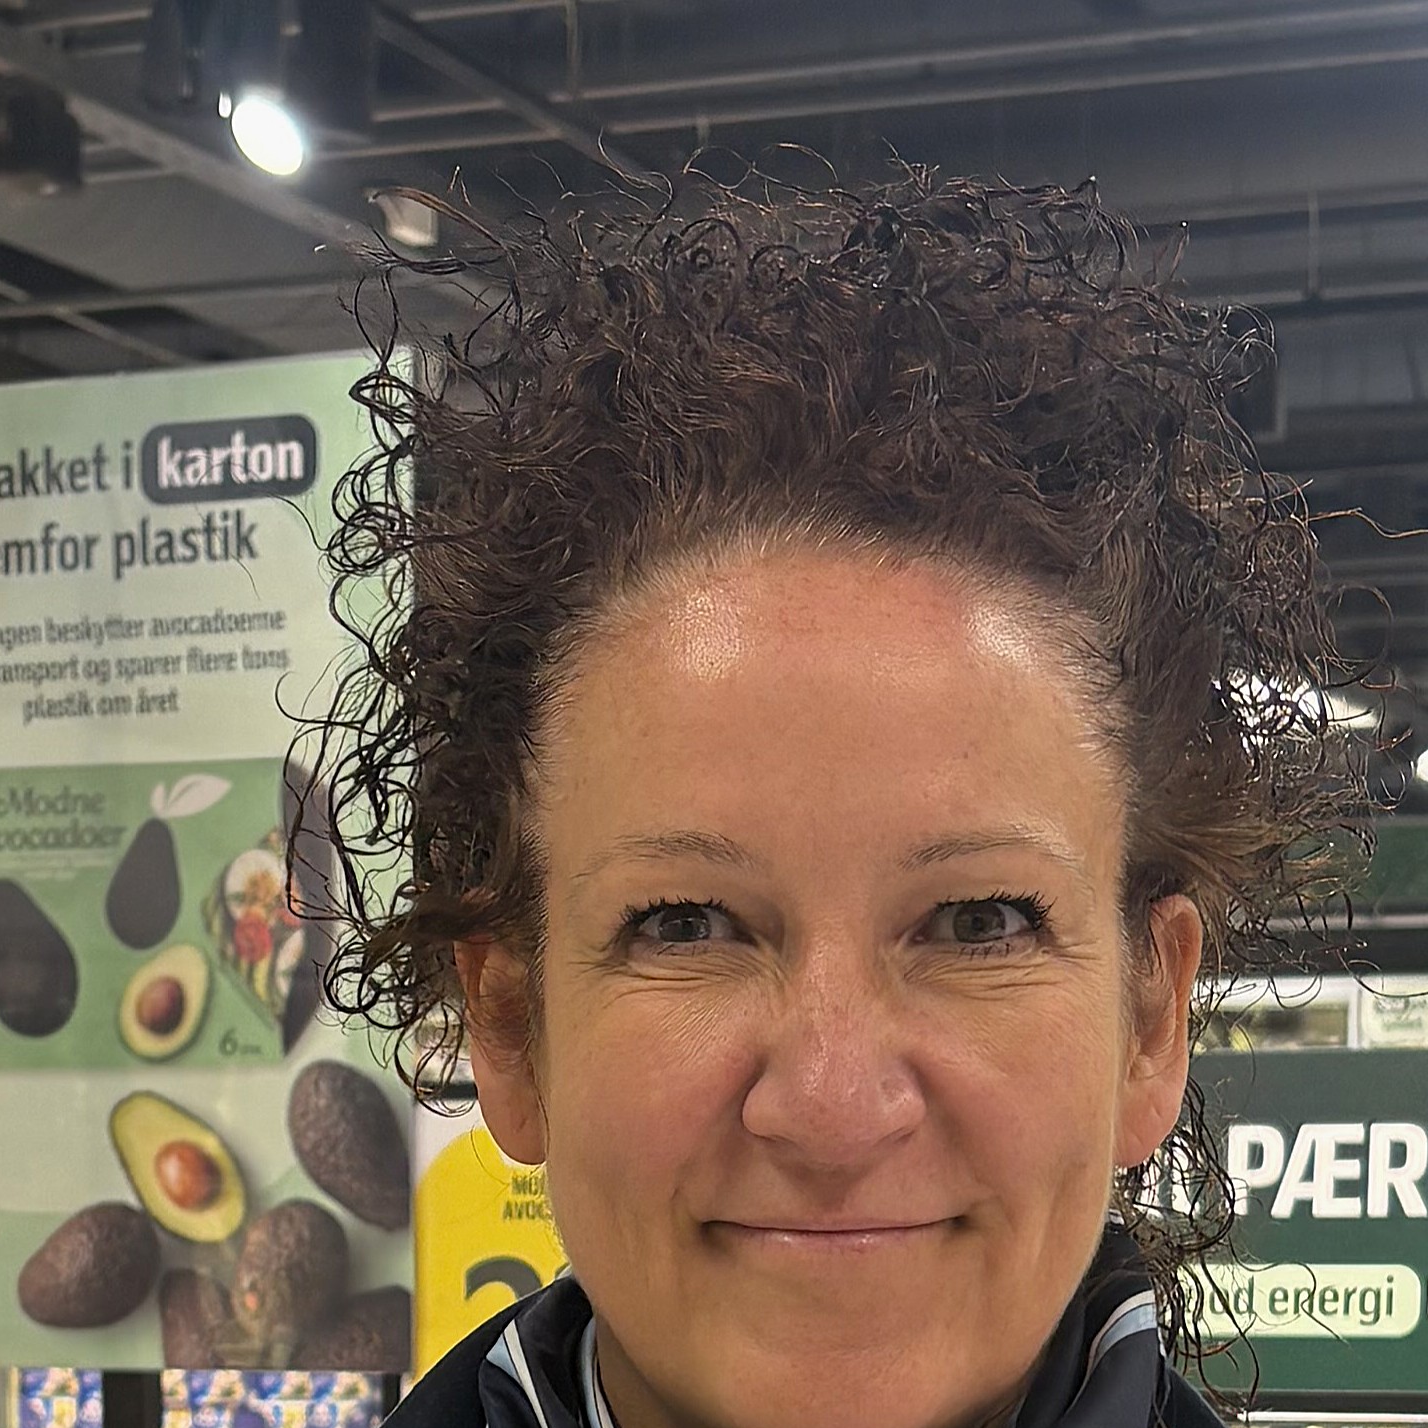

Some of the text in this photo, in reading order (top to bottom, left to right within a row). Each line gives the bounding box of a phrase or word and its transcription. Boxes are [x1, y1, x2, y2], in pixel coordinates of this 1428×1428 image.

[123, 441, 135, 491] i
[156, 431, 306, 491] karton
[113, 510, 259, 580] plastik
[45, 614, 145, 646] beskytter
[149, 609, 287, 637] avocadoerne
[83, 660, 112, 684] og
[115, 653, 183, 680] sparer
[186, 645, 238, 673] flere
[22, 687, 180, 725] plastik om året
[1268, 1275, 1395, 1326] energi
